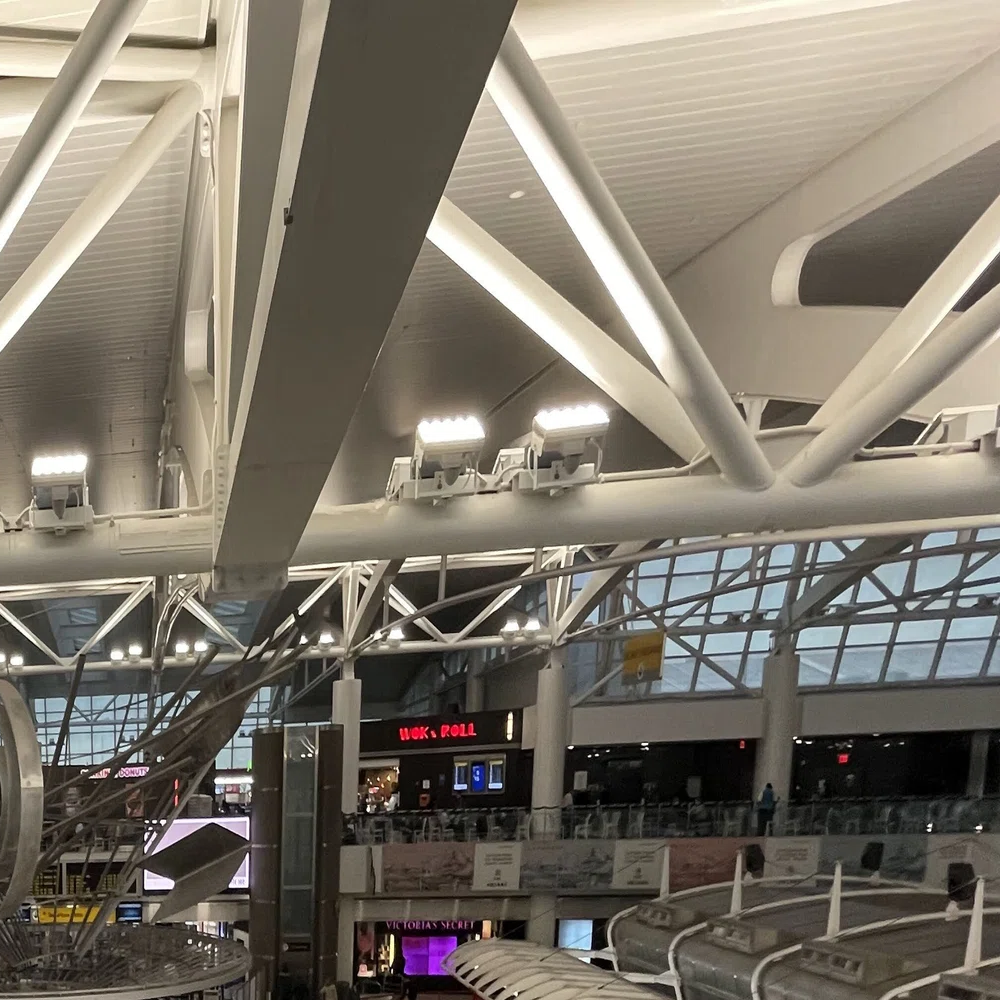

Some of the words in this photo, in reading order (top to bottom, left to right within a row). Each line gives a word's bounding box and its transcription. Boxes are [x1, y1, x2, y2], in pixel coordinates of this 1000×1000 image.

[399, 726, 429, 741] WOK
[440, 723, 477, 738] ROLL
[118, 766, 149, 778] DONUTS
[441, 920, 475, 930] SECRET
